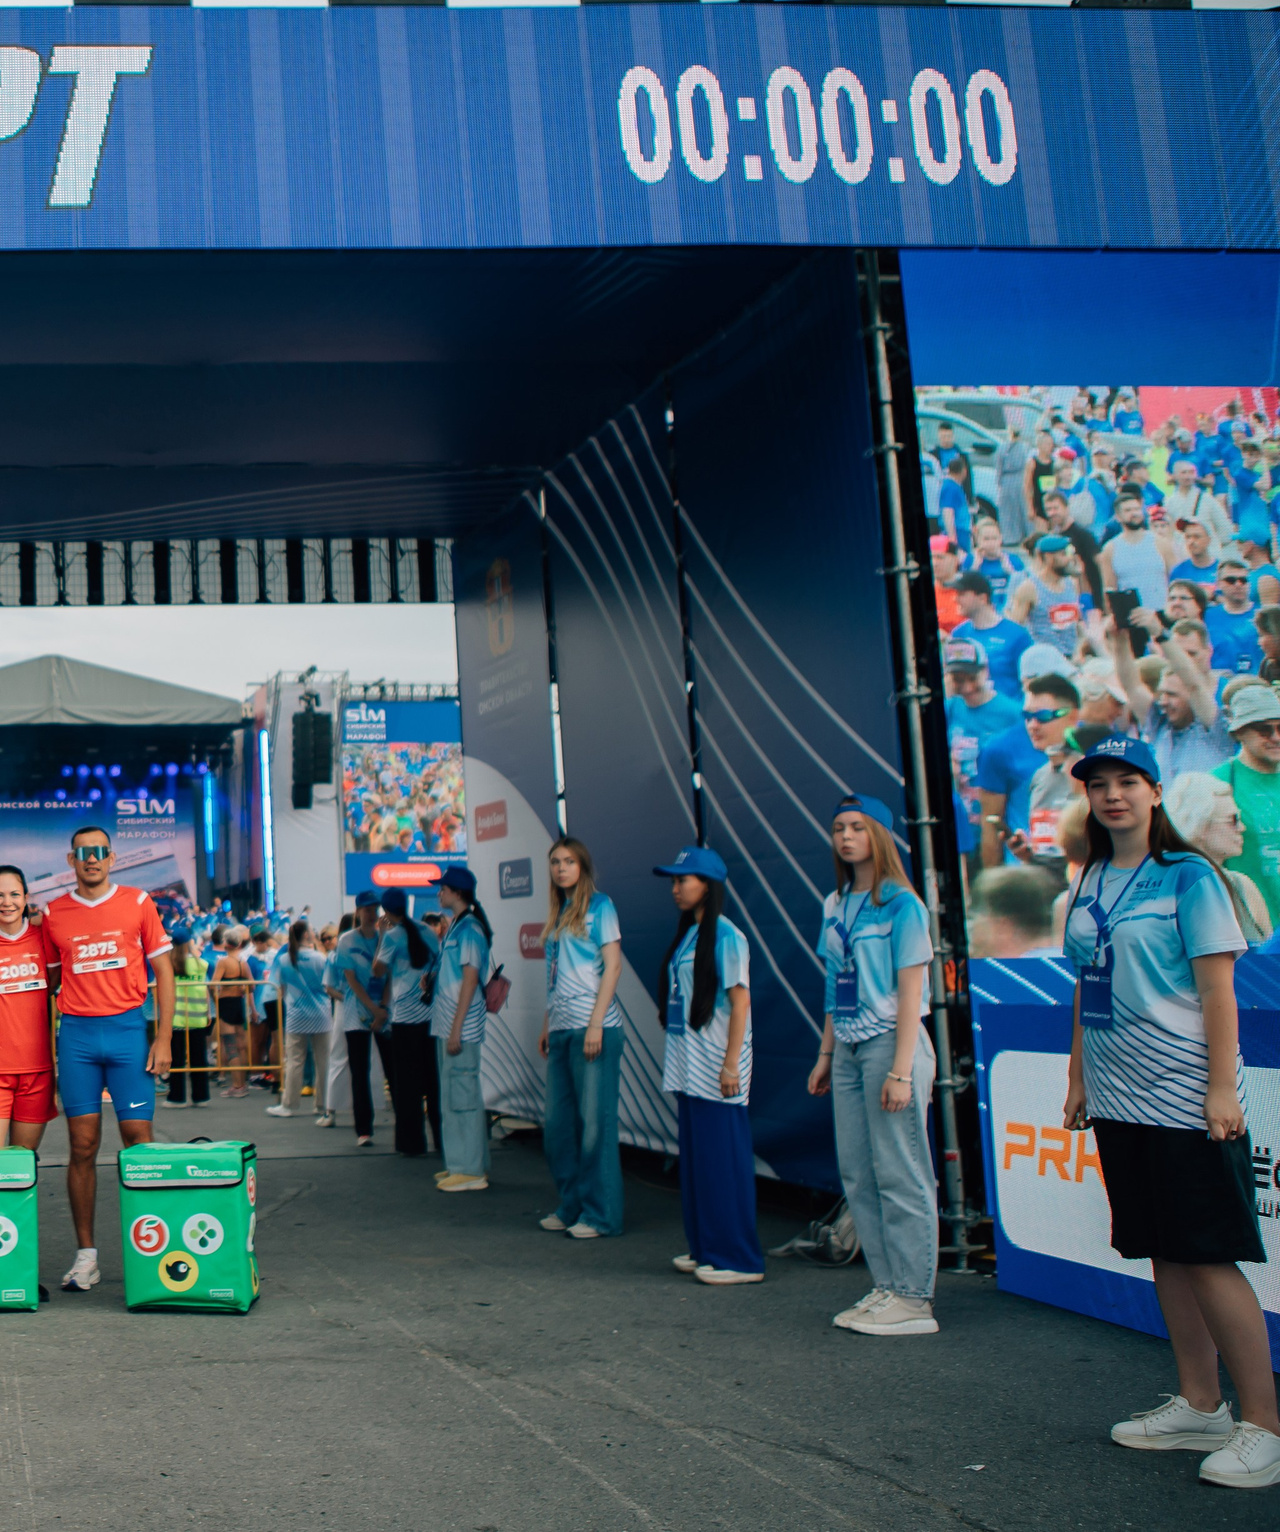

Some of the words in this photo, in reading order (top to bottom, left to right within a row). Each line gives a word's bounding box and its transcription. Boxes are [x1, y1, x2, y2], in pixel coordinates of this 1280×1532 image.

[617, 64, 1018, 186] 00:00:00
[44, 800, 93, 809] ОБЛАСТИ
[117, 816, 175, 825] СИБИРСКИЙ
[117, 831, 175, 839] МАРАФОН
[77, 940, 118, 959] 2875
[0, 962, 39, 980] 2080
[125, 1164, 172, 1172] Доставляем
[126, 1172, 163, 1180] продукты
